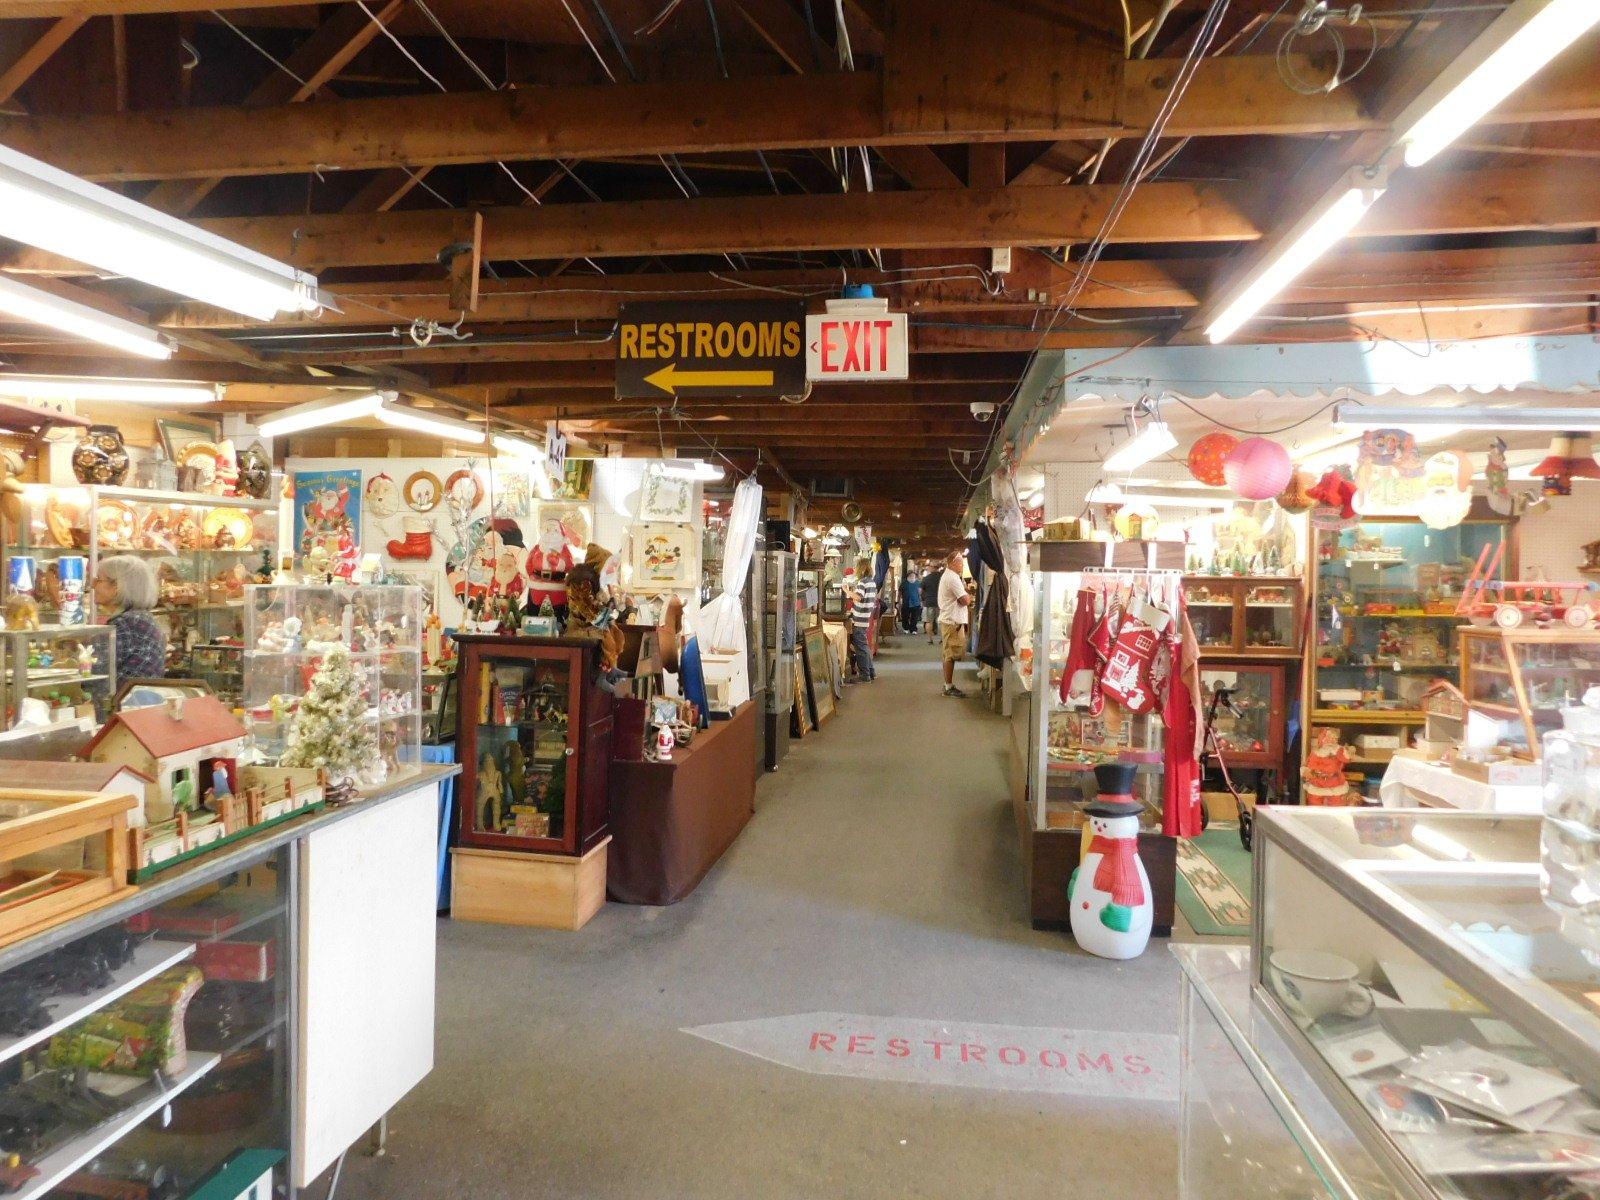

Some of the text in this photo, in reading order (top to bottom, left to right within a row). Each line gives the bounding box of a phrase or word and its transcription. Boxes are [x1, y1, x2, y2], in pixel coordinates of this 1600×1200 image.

[620, 320, 801, 359] RESTROOMS
[820, 320, 893, 373] EXIT
[808, 1031, 1152, 1075] RESTROOMS
